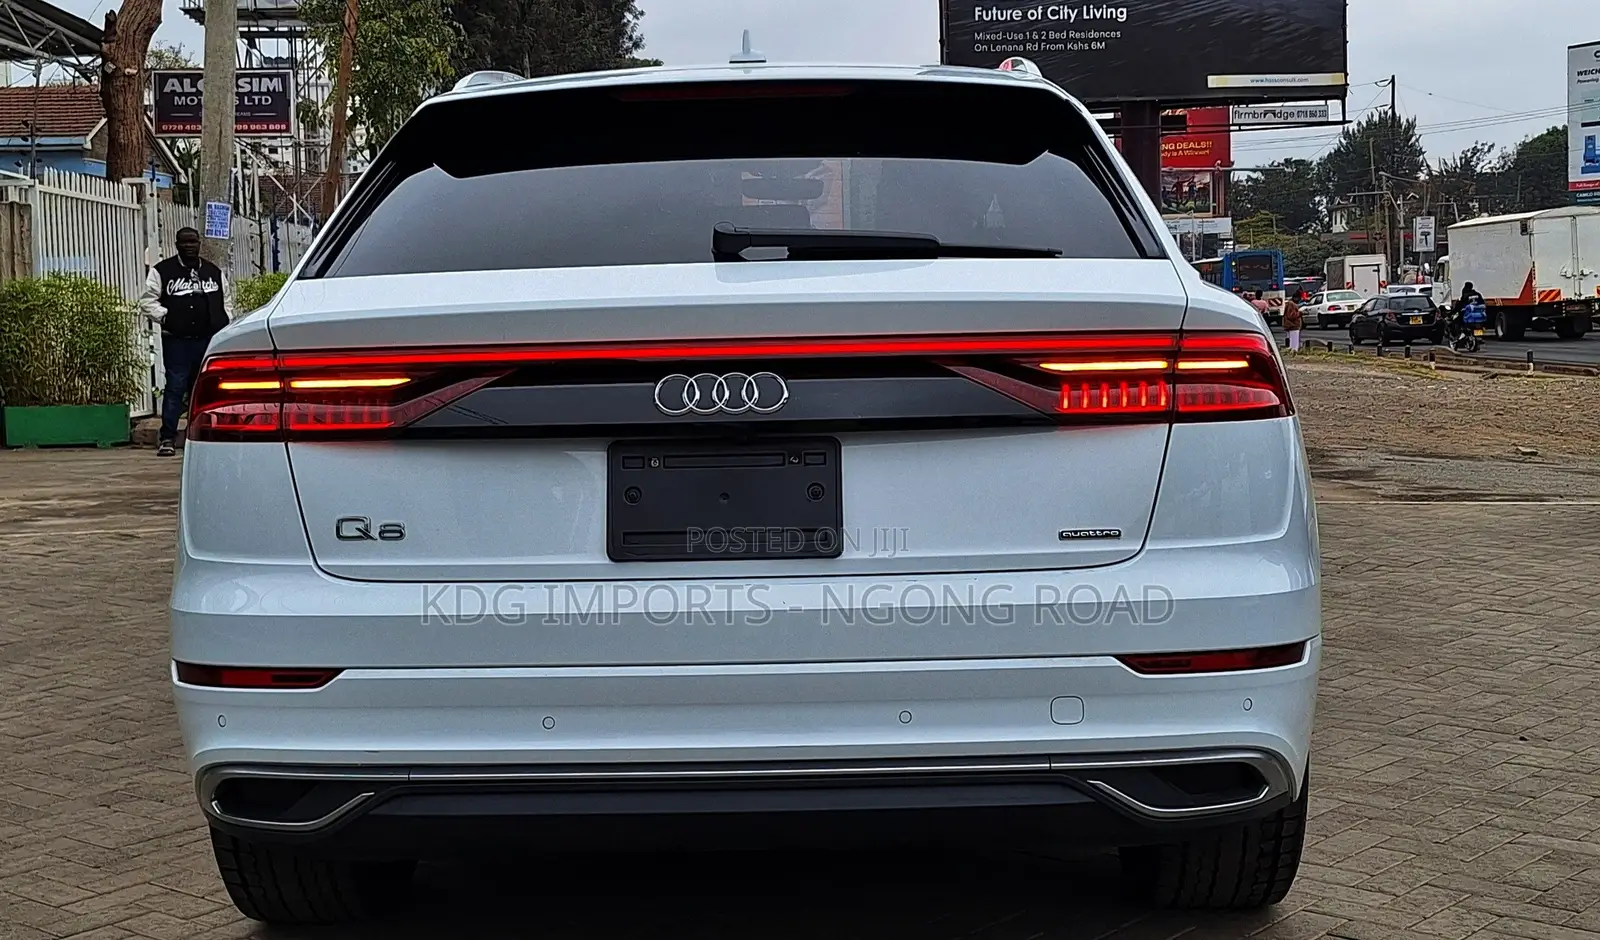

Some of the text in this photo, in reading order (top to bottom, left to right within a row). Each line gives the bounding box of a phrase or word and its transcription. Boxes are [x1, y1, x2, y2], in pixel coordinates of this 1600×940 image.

[975, 4, 1127, 23] Future of City Living
[974, 30, 1121, 41] Mixed-Use 1 & 2 Bed Residences
[974, 44, 988, 52] On
[1026, 42, 1038, 51] Rd
[1041, 42, 1065, 51] From
[1067, 42, 1089, 51] Kshs
[1091, 41, 1106, 50] 6M
[163, 77, 283, 93] ALSIM
[244, 95, 272, 105] LTD
[1176, 141, 1213, 150] DEALS!!
[335, 515, 407, 542] Q8
[1061, 529, 1120, 538] quattro
